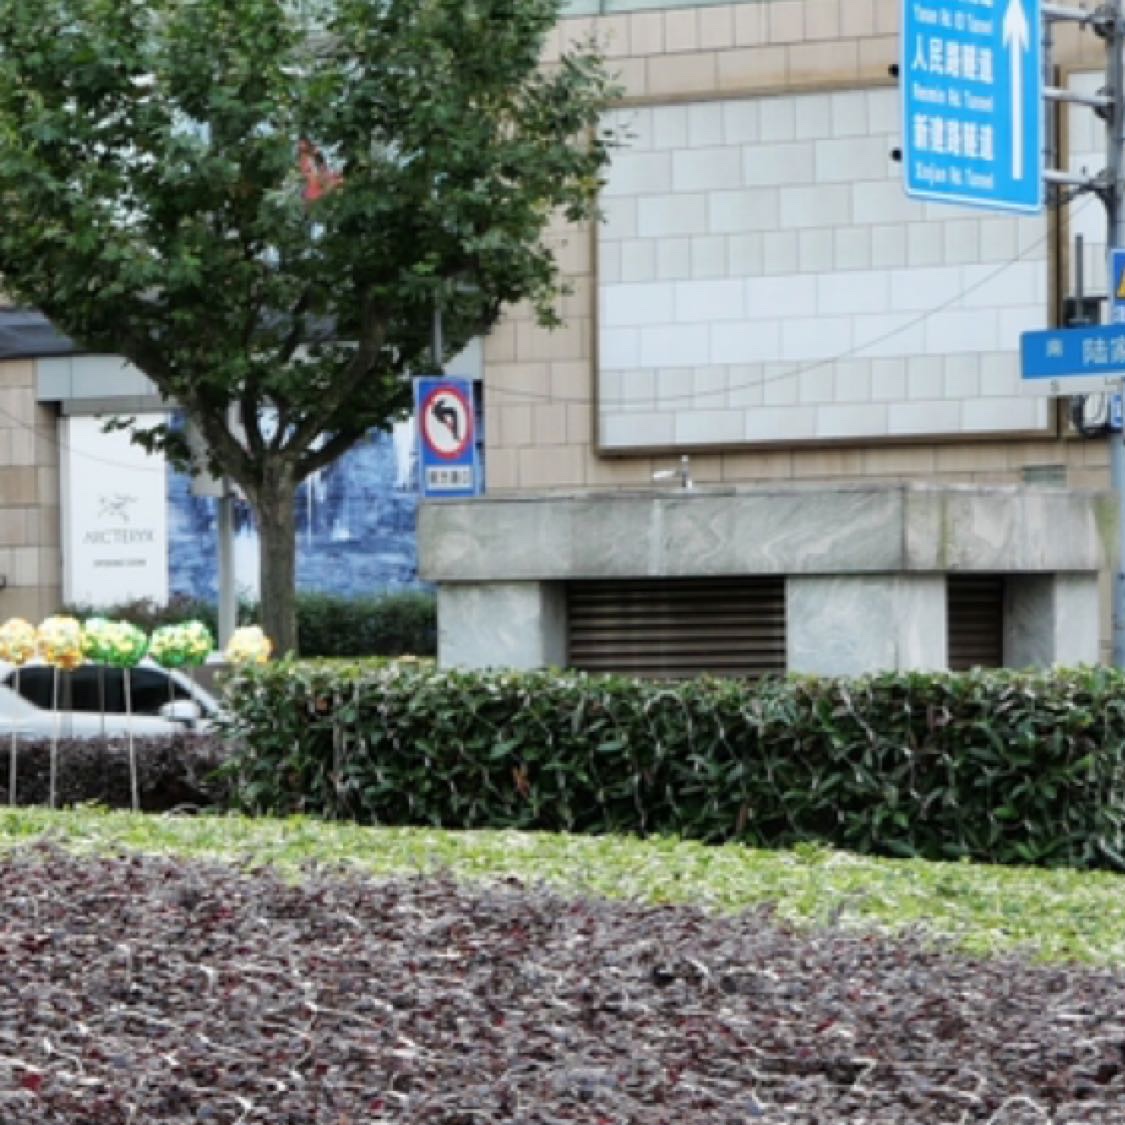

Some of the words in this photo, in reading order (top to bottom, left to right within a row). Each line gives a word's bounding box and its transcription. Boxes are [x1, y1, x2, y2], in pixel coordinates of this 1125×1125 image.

[912, 34, 993, 84] 人民路隧道
